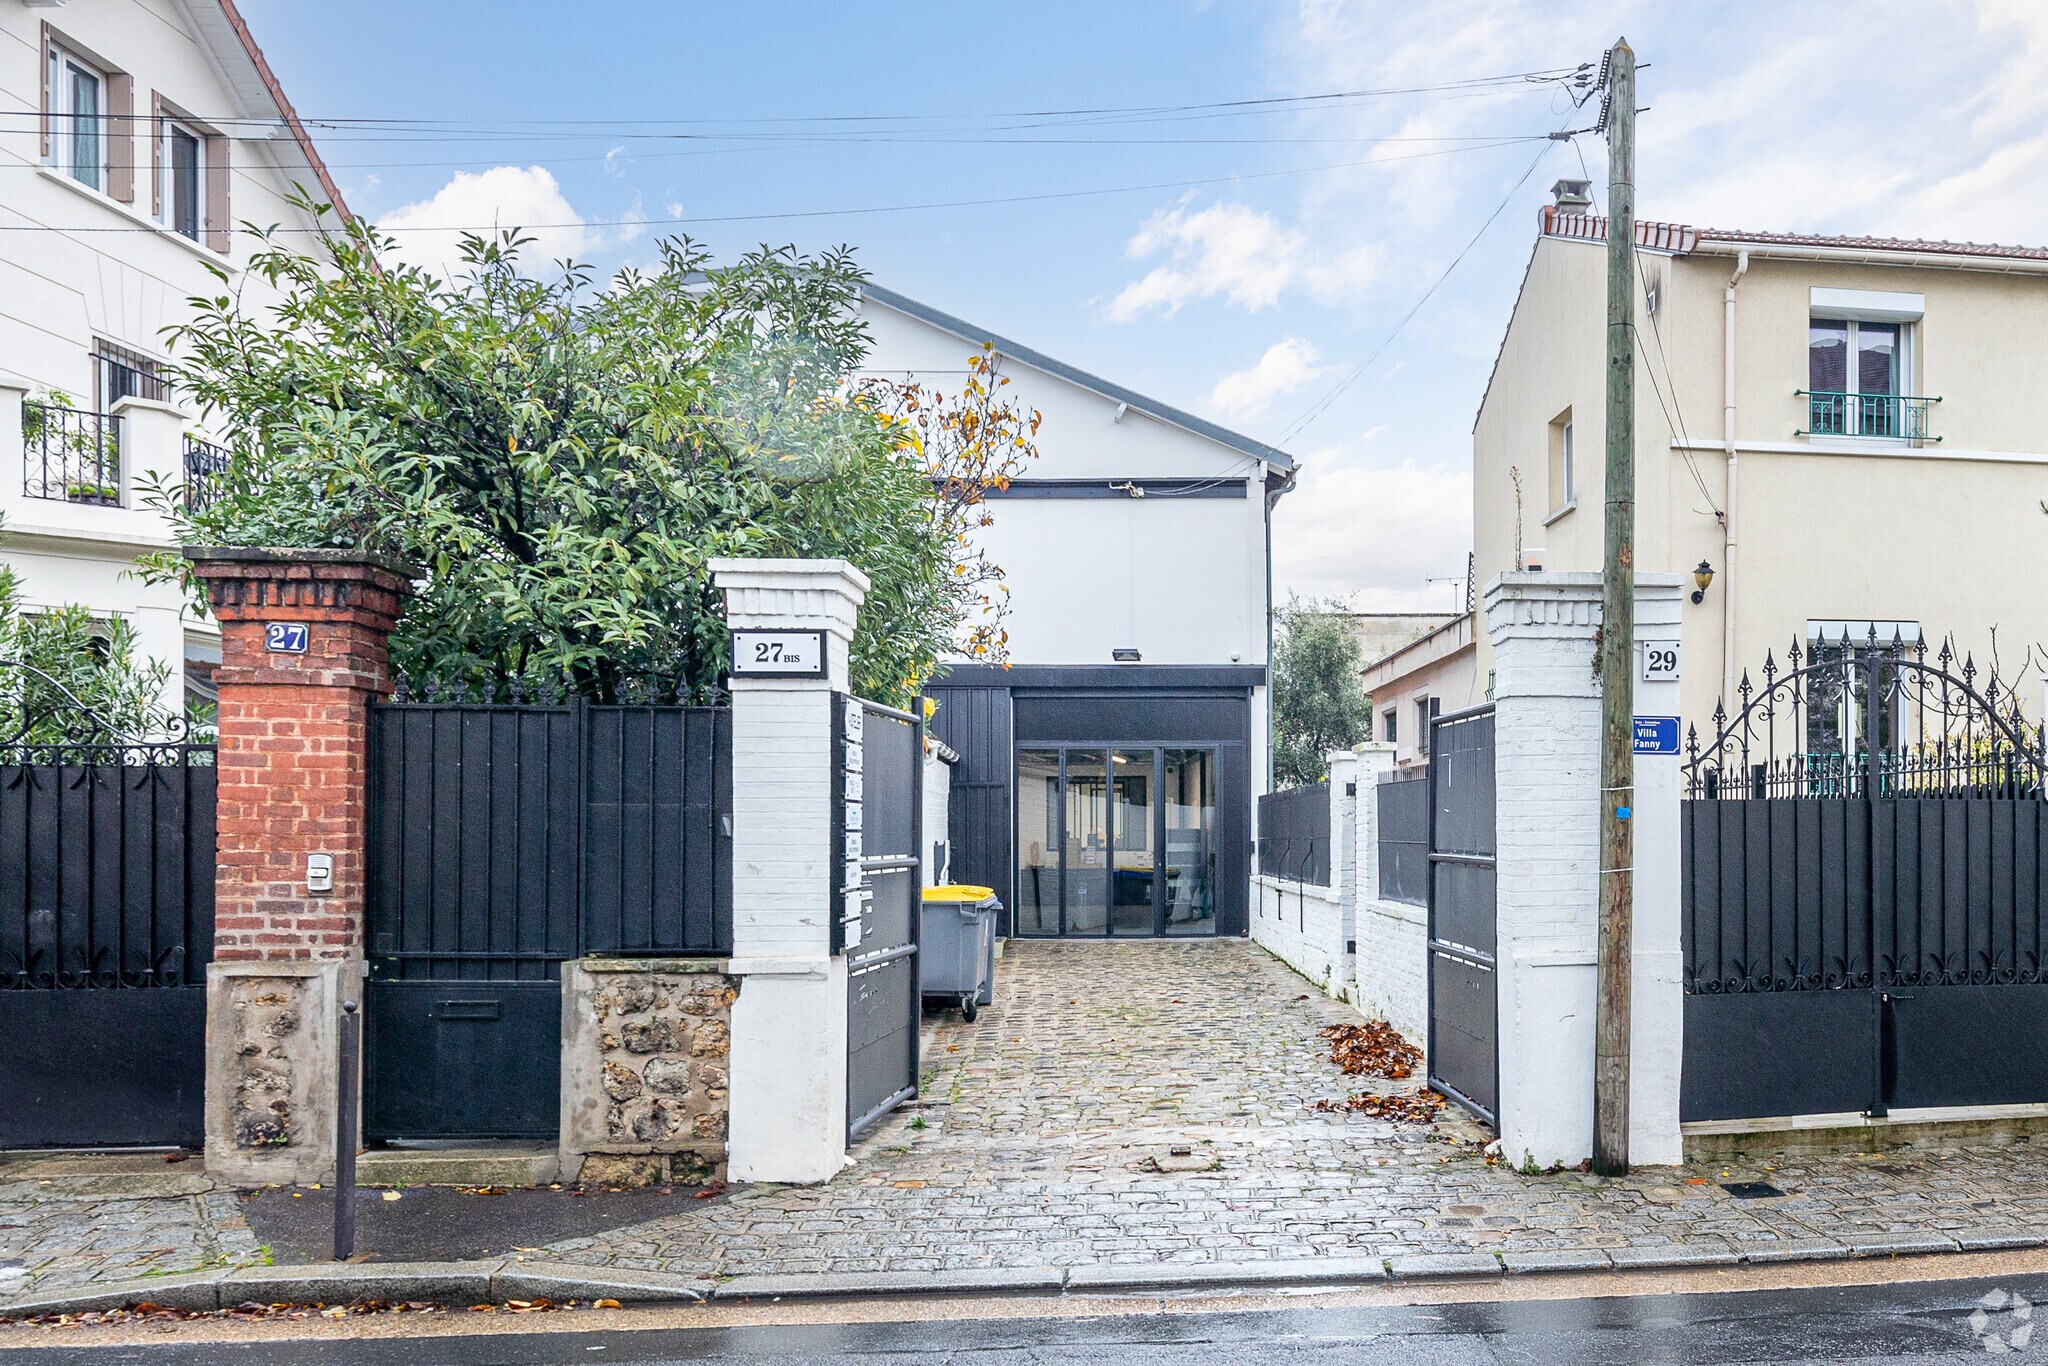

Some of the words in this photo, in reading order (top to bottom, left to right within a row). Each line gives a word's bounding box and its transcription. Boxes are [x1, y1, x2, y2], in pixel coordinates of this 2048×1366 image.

[270, 625, 303, 649] 27
[755, 642, 783, 663] 27
[783, 654, 801, 663] BIS
[1649, 650, 1677, 672] 29
[1637, 728, 1658, 738] Villa
[1634, 739, 1661, 750] Fanny
